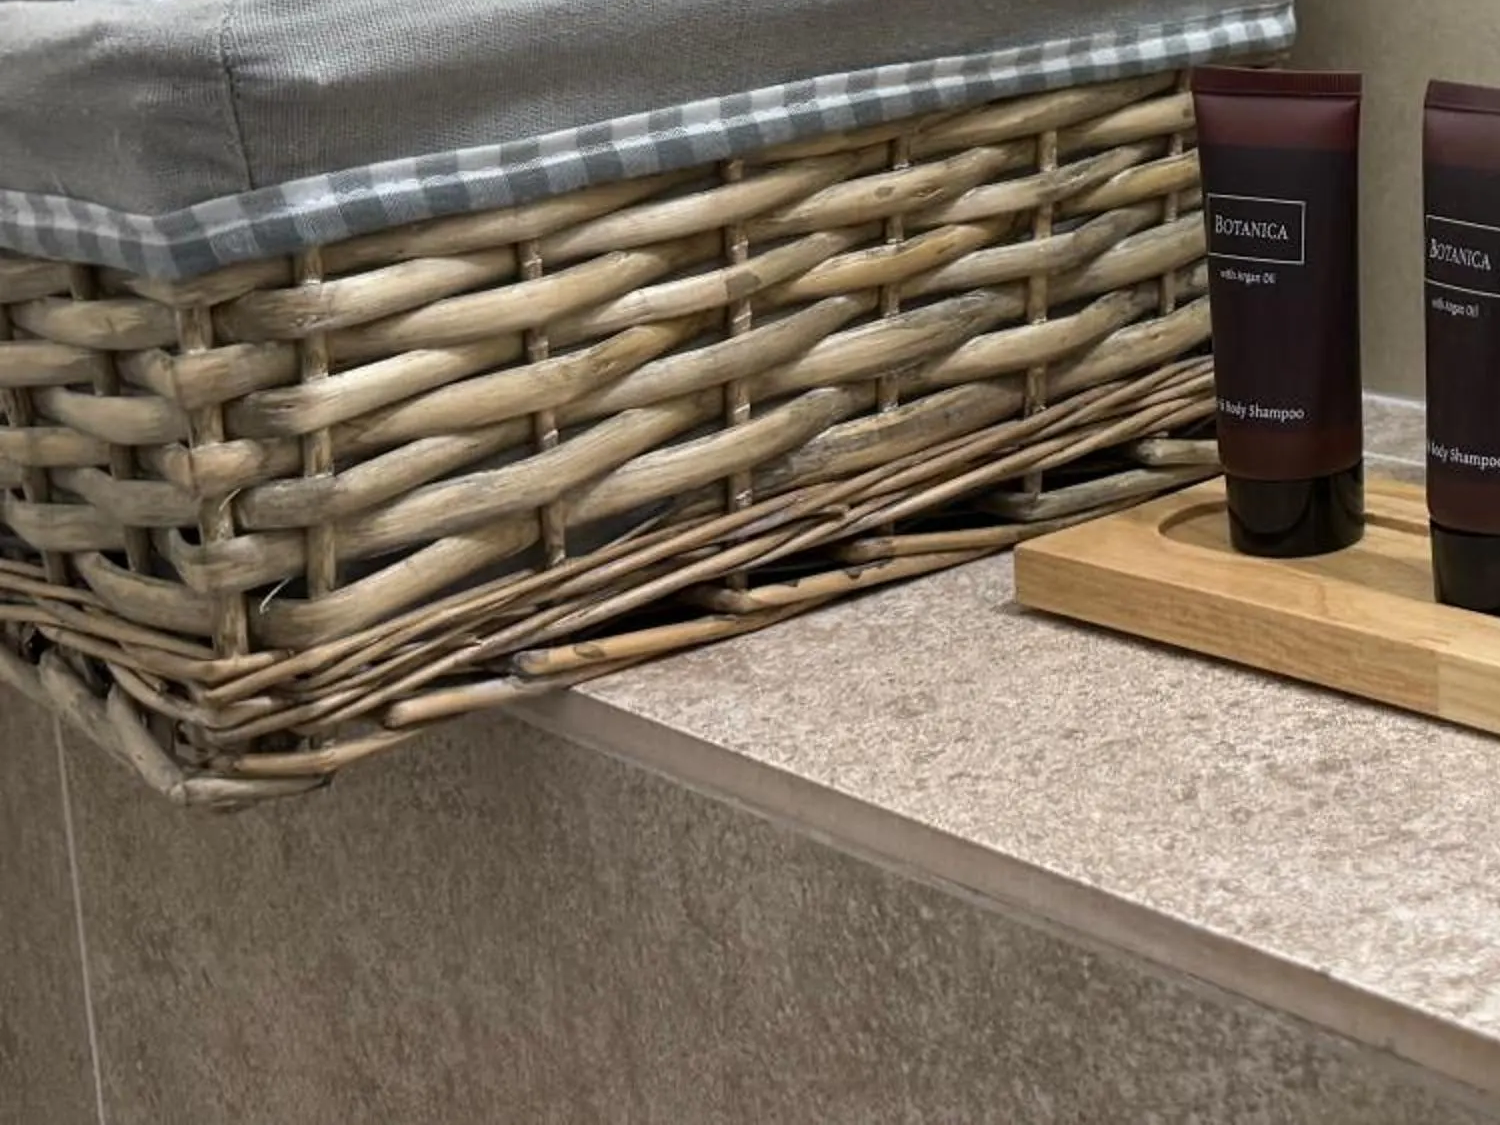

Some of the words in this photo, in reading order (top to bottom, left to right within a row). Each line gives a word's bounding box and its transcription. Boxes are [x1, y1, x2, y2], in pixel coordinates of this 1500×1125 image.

[1215, 215, 1288, 240] BOTANICA
[1429, 238, 1491, 271] BOTANICA
[1249, 402, 1305, 423] Shampoo
